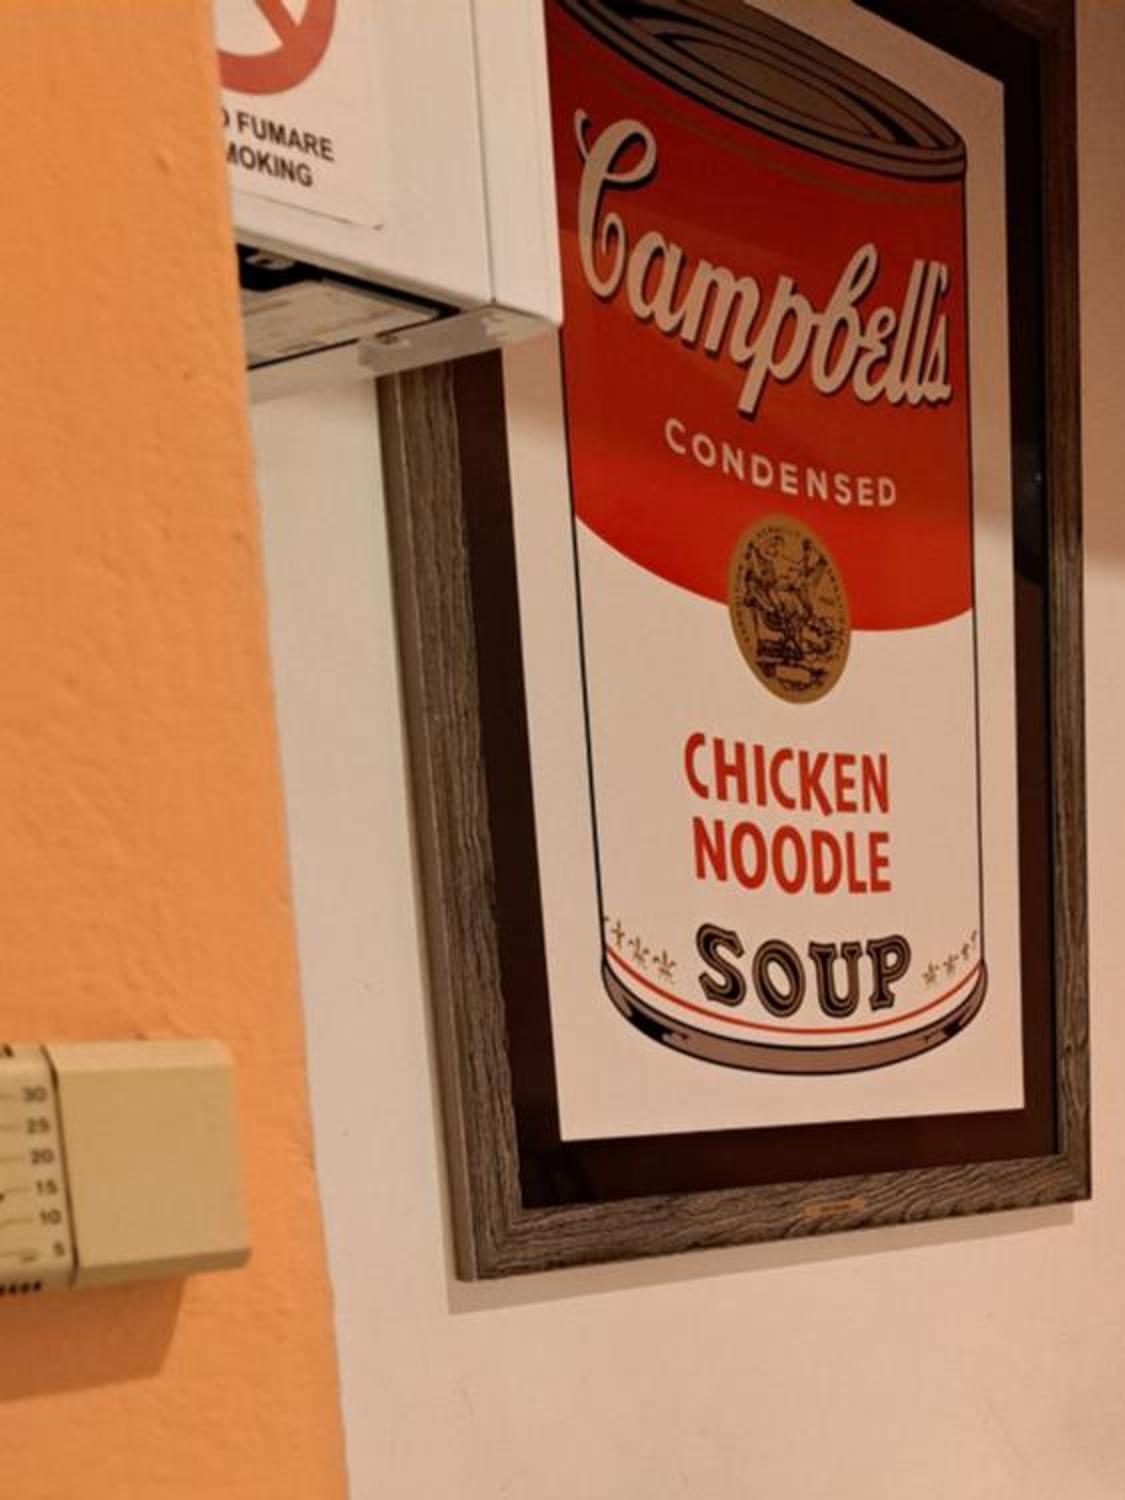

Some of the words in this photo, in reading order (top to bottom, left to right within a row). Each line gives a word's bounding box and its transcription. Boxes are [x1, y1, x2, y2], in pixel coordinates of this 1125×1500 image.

[236, 111, 336, 163] FUMARE
[226, 142, 314, 188] MOKING
[664, 418, 896, 507] CONDENSED
[684, 732, 889, 817] CHICKEN
[692, 816, 892, 895] NOODLE
[695, 922, 911, 1019] SOUP
[27, 1117, 50, 1135] 25
[31, 1149, 54, 1165] 20
[36, 1179, 58, 1195] 15
[40, 1208, 62, 1225] 10
